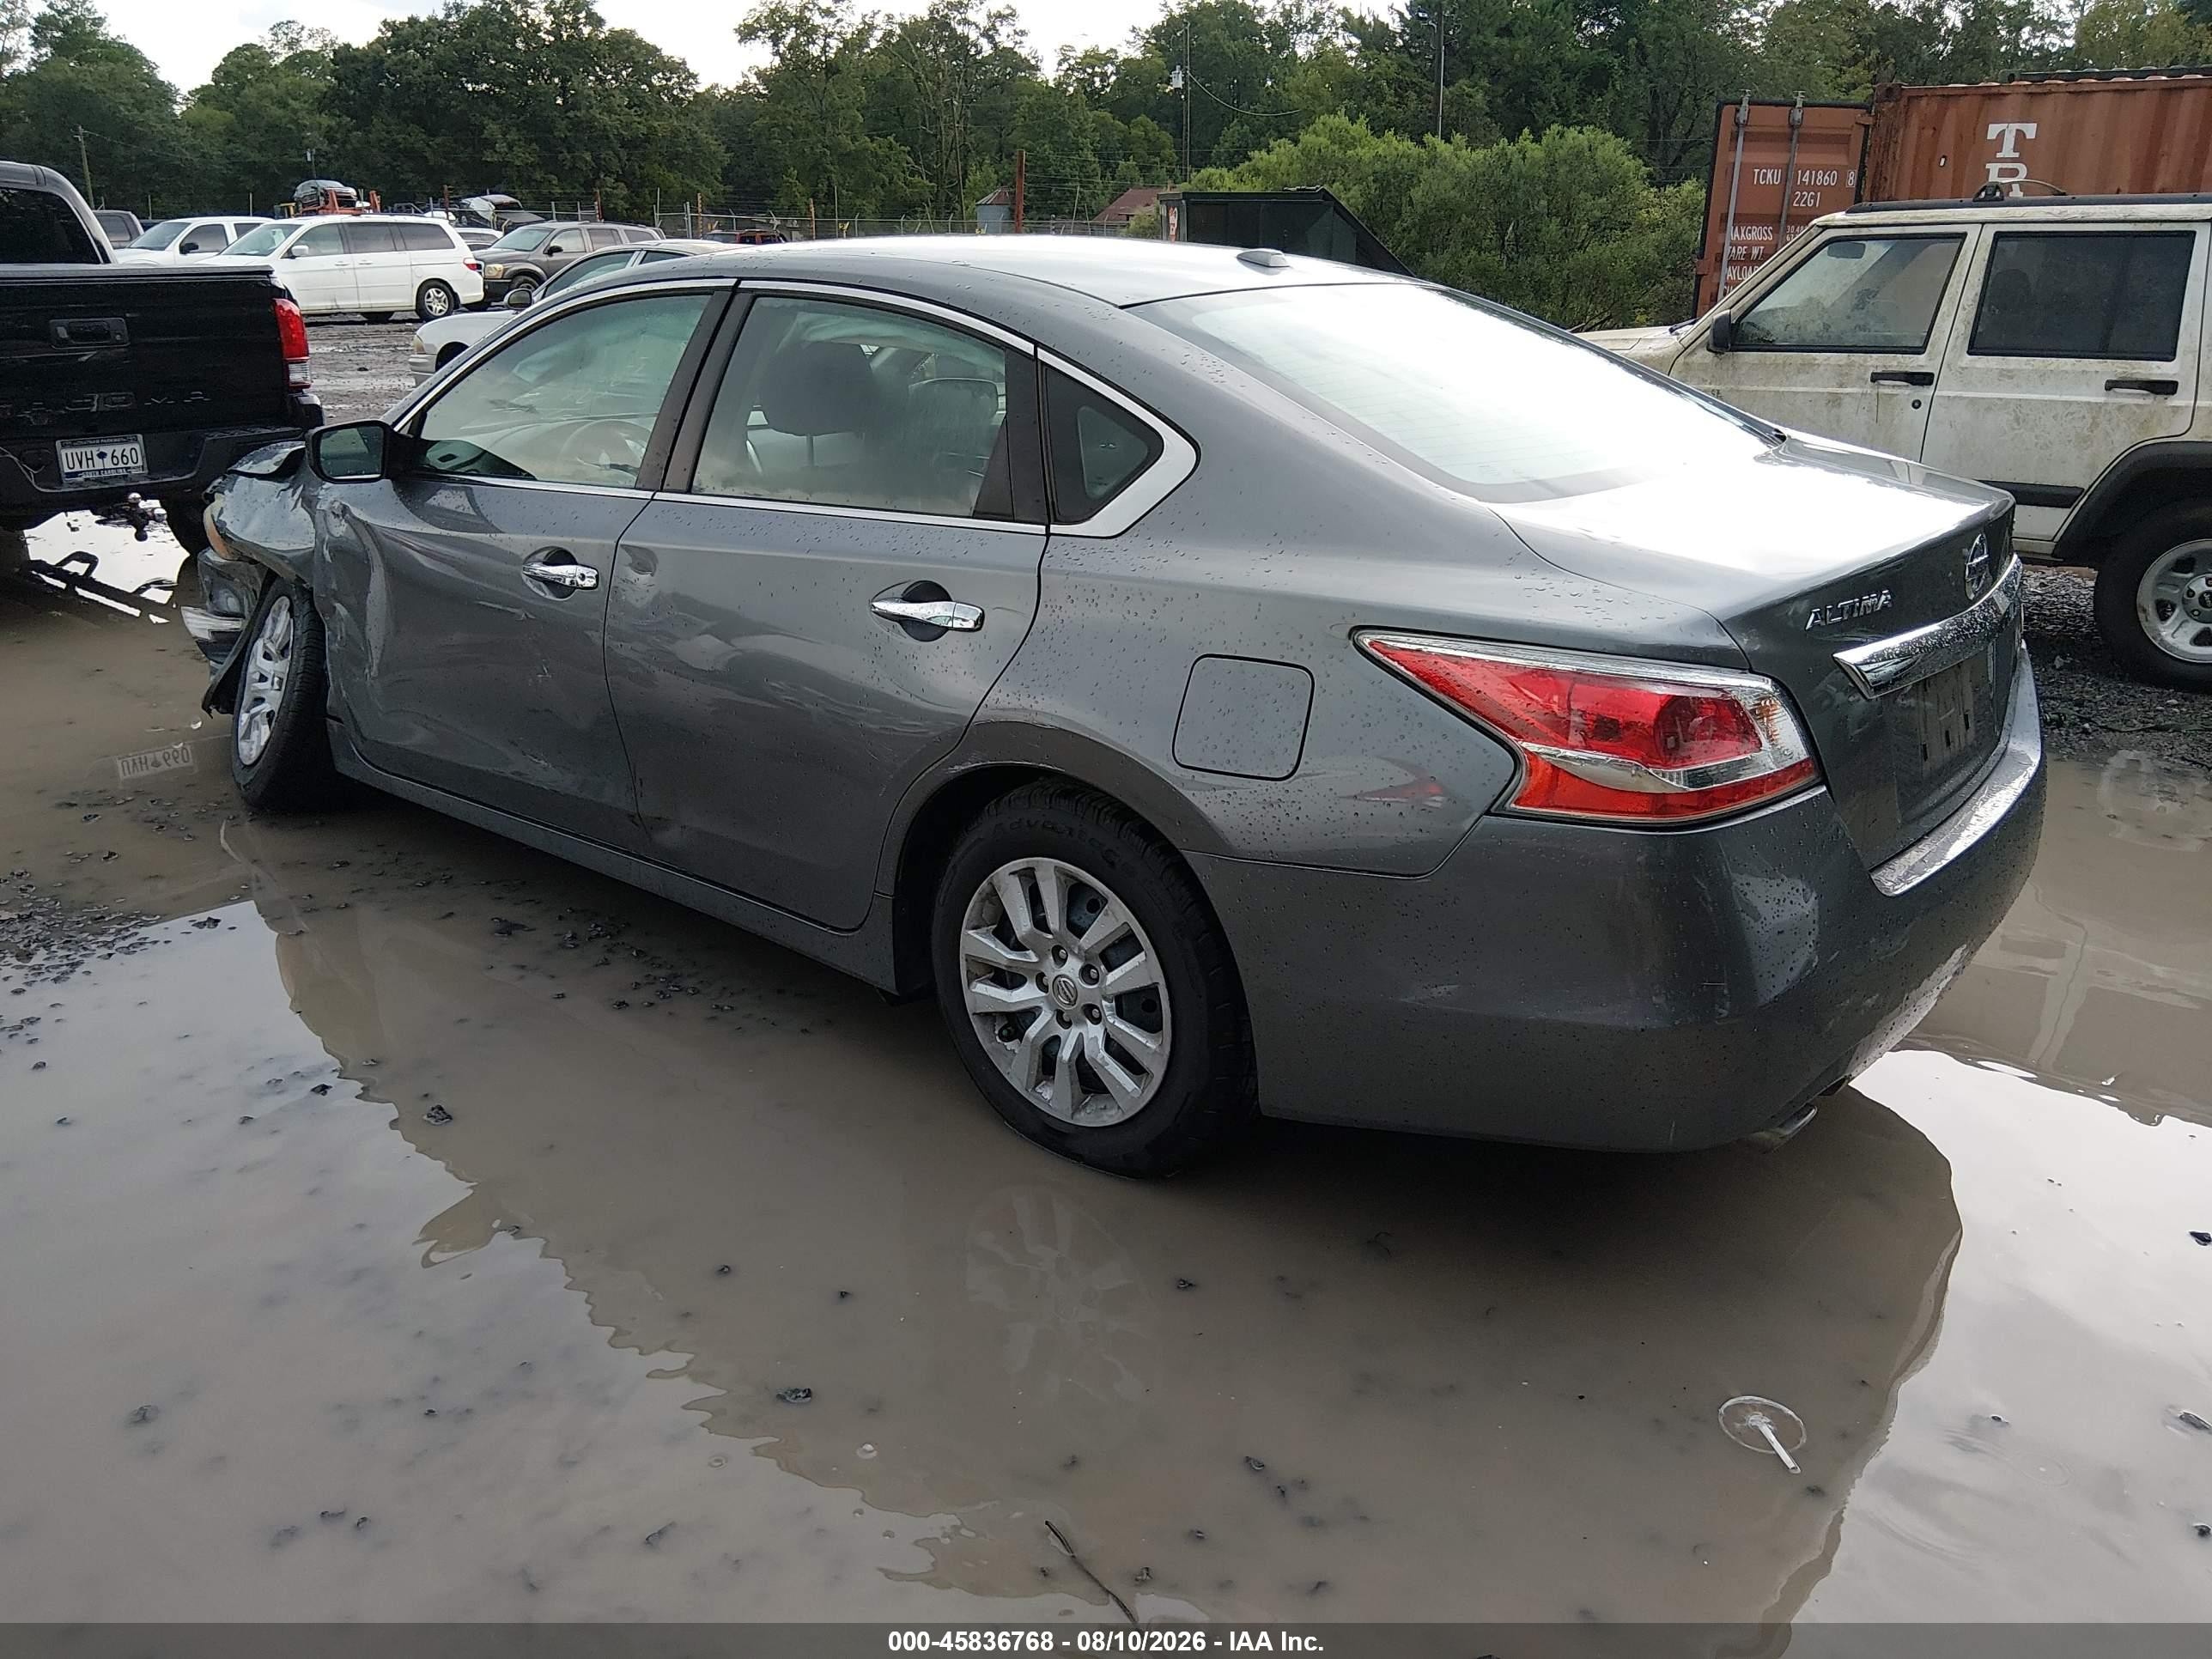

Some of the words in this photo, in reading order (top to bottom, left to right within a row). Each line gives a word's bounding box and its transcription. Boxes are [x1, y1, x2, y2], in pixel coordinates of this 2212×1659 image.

[1753, 169, 1782, 185] TCKU
[1796, 169, 1838, 186] 141860
[1848, 172, 1855, 186] 8
[1793, 191, 1821, 208] 22G1
[65, 450, 95, 470] UVH
[111, 447, 138, 465] 660
[1805, 590, 1893, 630] ALTIMA
